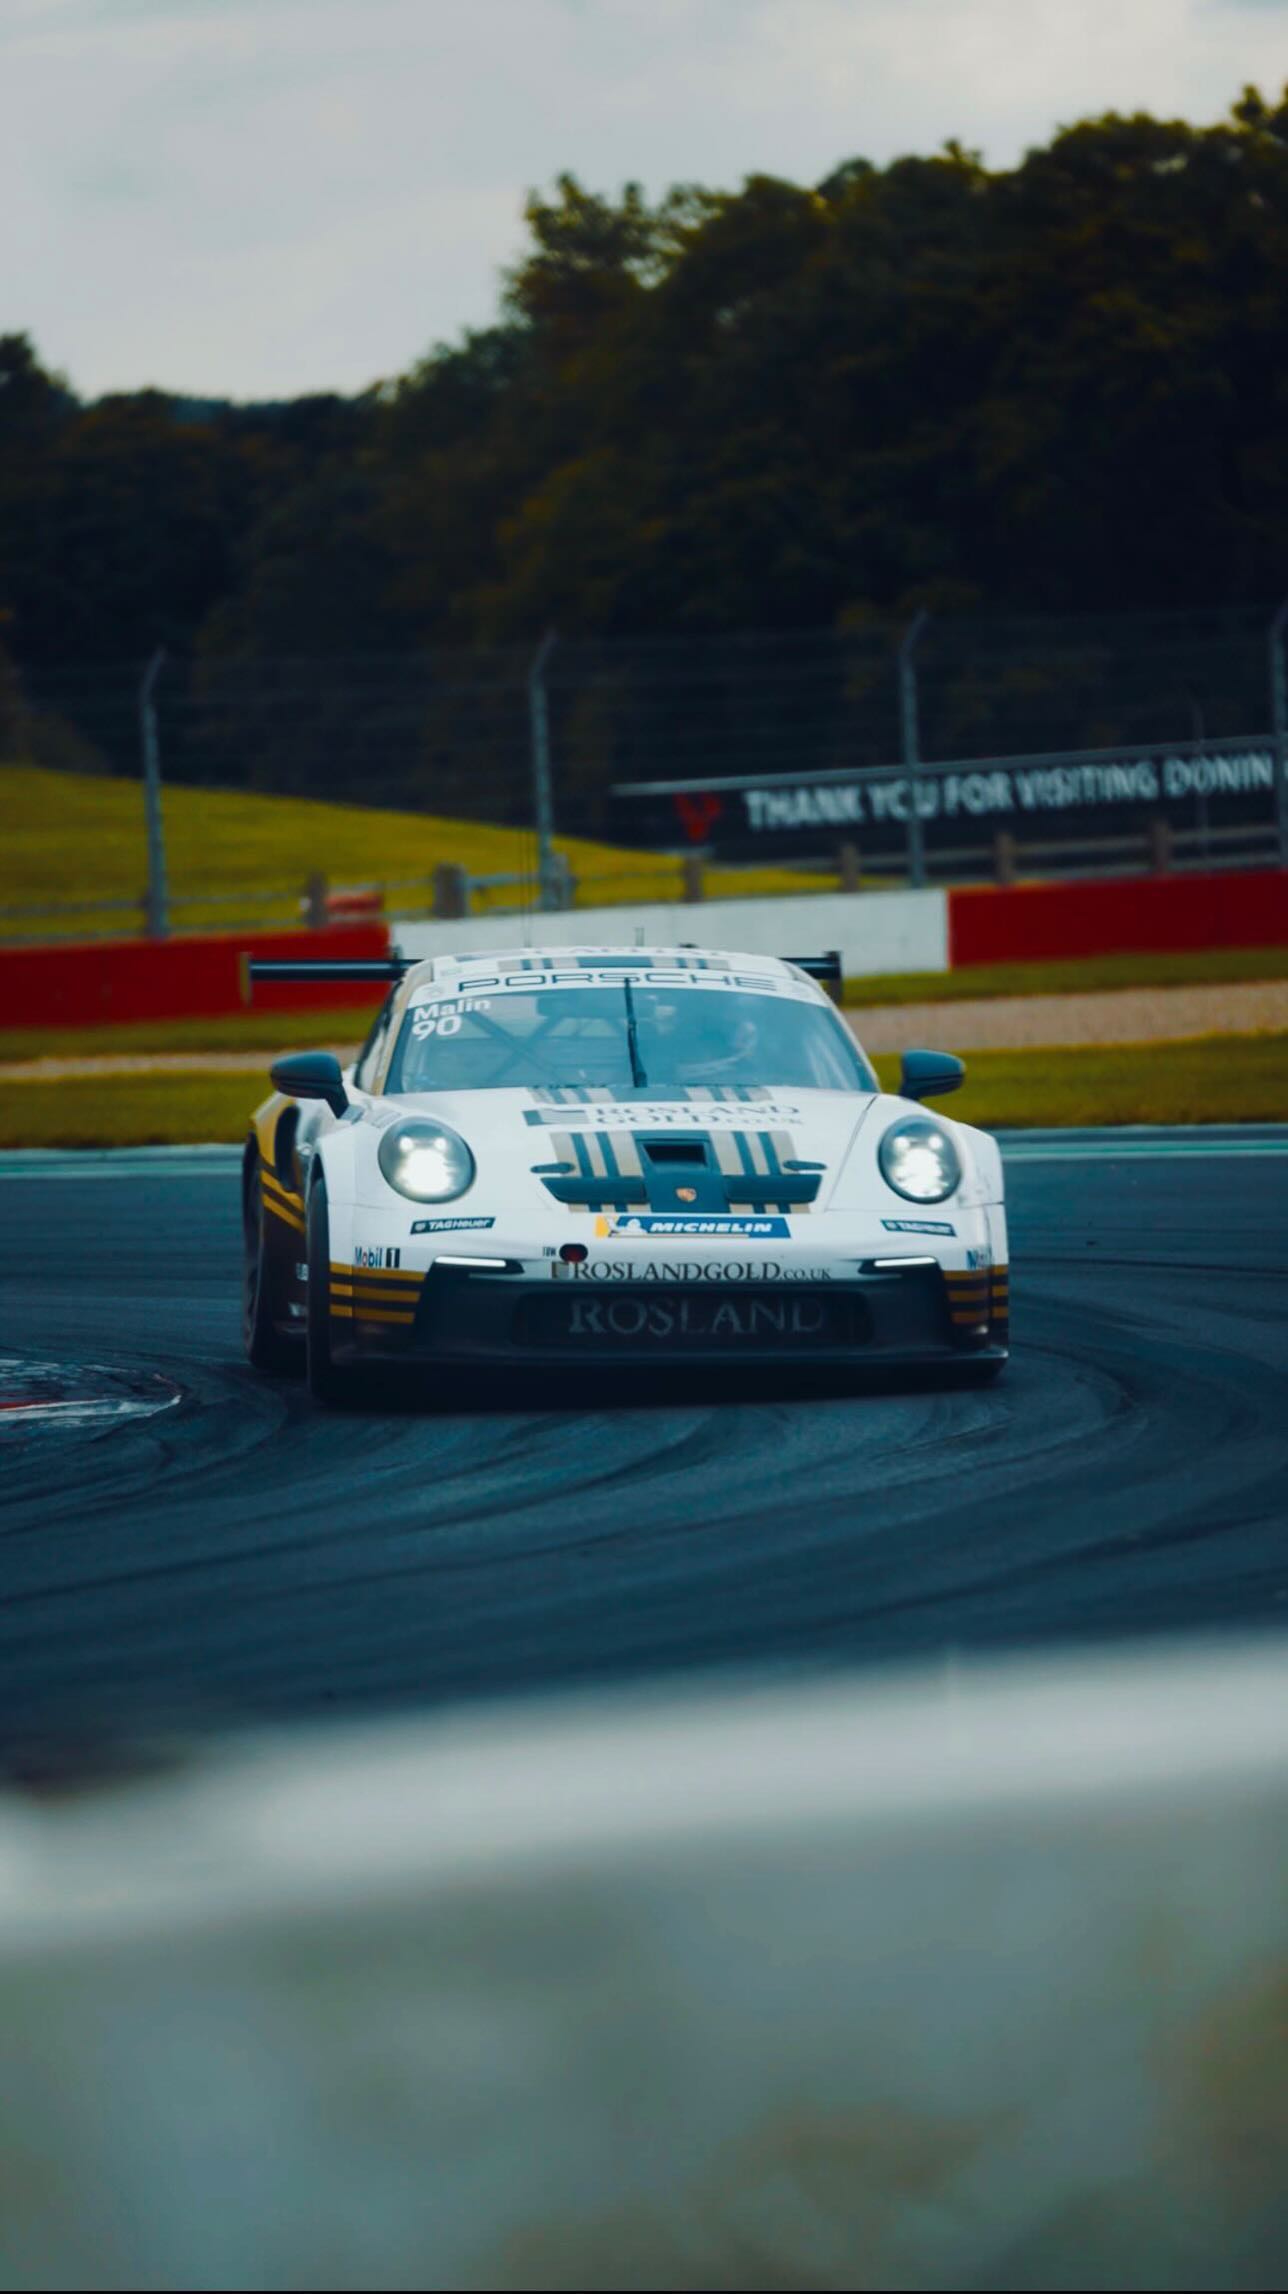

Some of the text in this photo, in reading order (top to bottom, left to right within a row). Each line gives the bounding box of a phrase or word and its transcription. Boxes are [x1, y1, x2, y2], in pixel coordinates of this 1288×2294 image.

[745, 752, 1288, 829] THANK YOU FOR VISITING DONIN
[458, 972, 778, 993] PORSCHE
[413, 998, 491, 1022] Malin
[412, 1014, 462, 1041] 90
[650, 1220, 773, 1234] MICHELIN
[354, 1246, 399, 1268] Mobil 1
[572, 1261, 832, 1281] ROSLANDGOLD.CO.UK
[568, 1299, 824, 1338] ROSLAND
